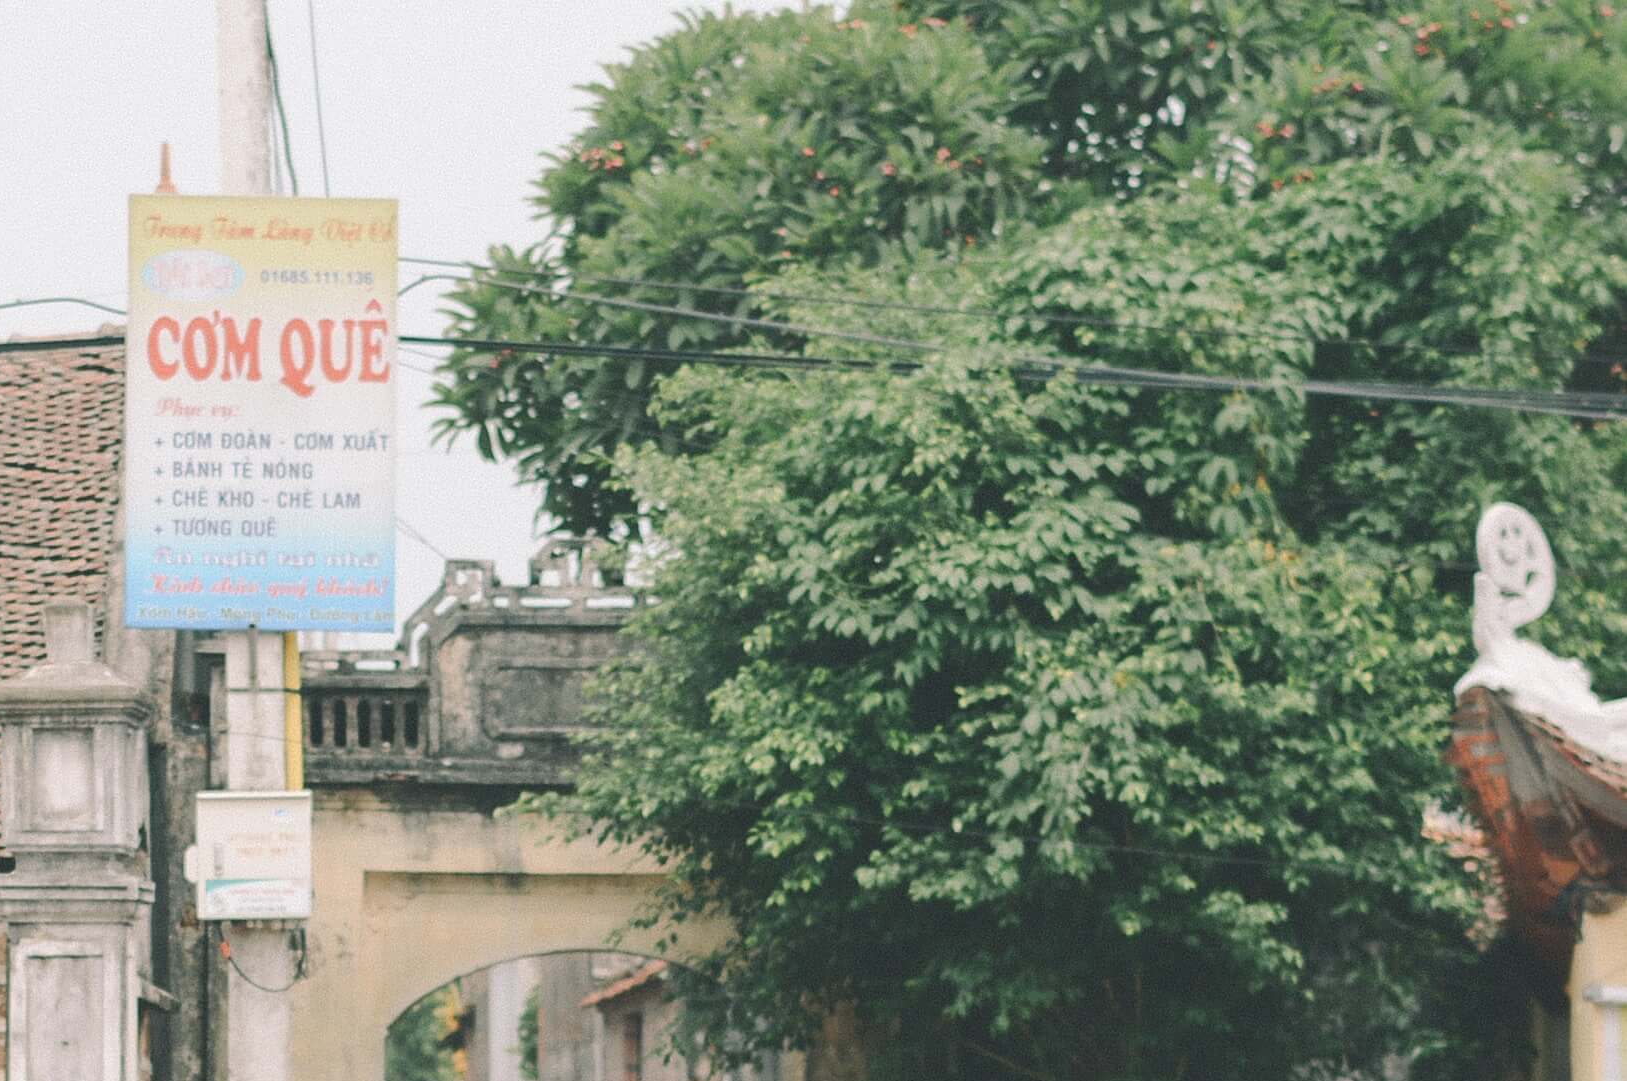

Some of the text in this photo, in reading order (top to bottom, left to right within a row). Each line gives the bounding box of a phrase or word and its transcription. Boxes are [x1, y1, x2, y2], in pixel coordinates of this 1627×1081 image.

[147, 298, 391, 398] CƠM QUÊ
[172, 431, 213, 450] CƠM
[220, 429, 272, 450] ĐOÀN
[293, 431, 334, 451] CƠM
[322, 491, 362, 510] LAM
[241, 517, 278, 538] QUÊ
